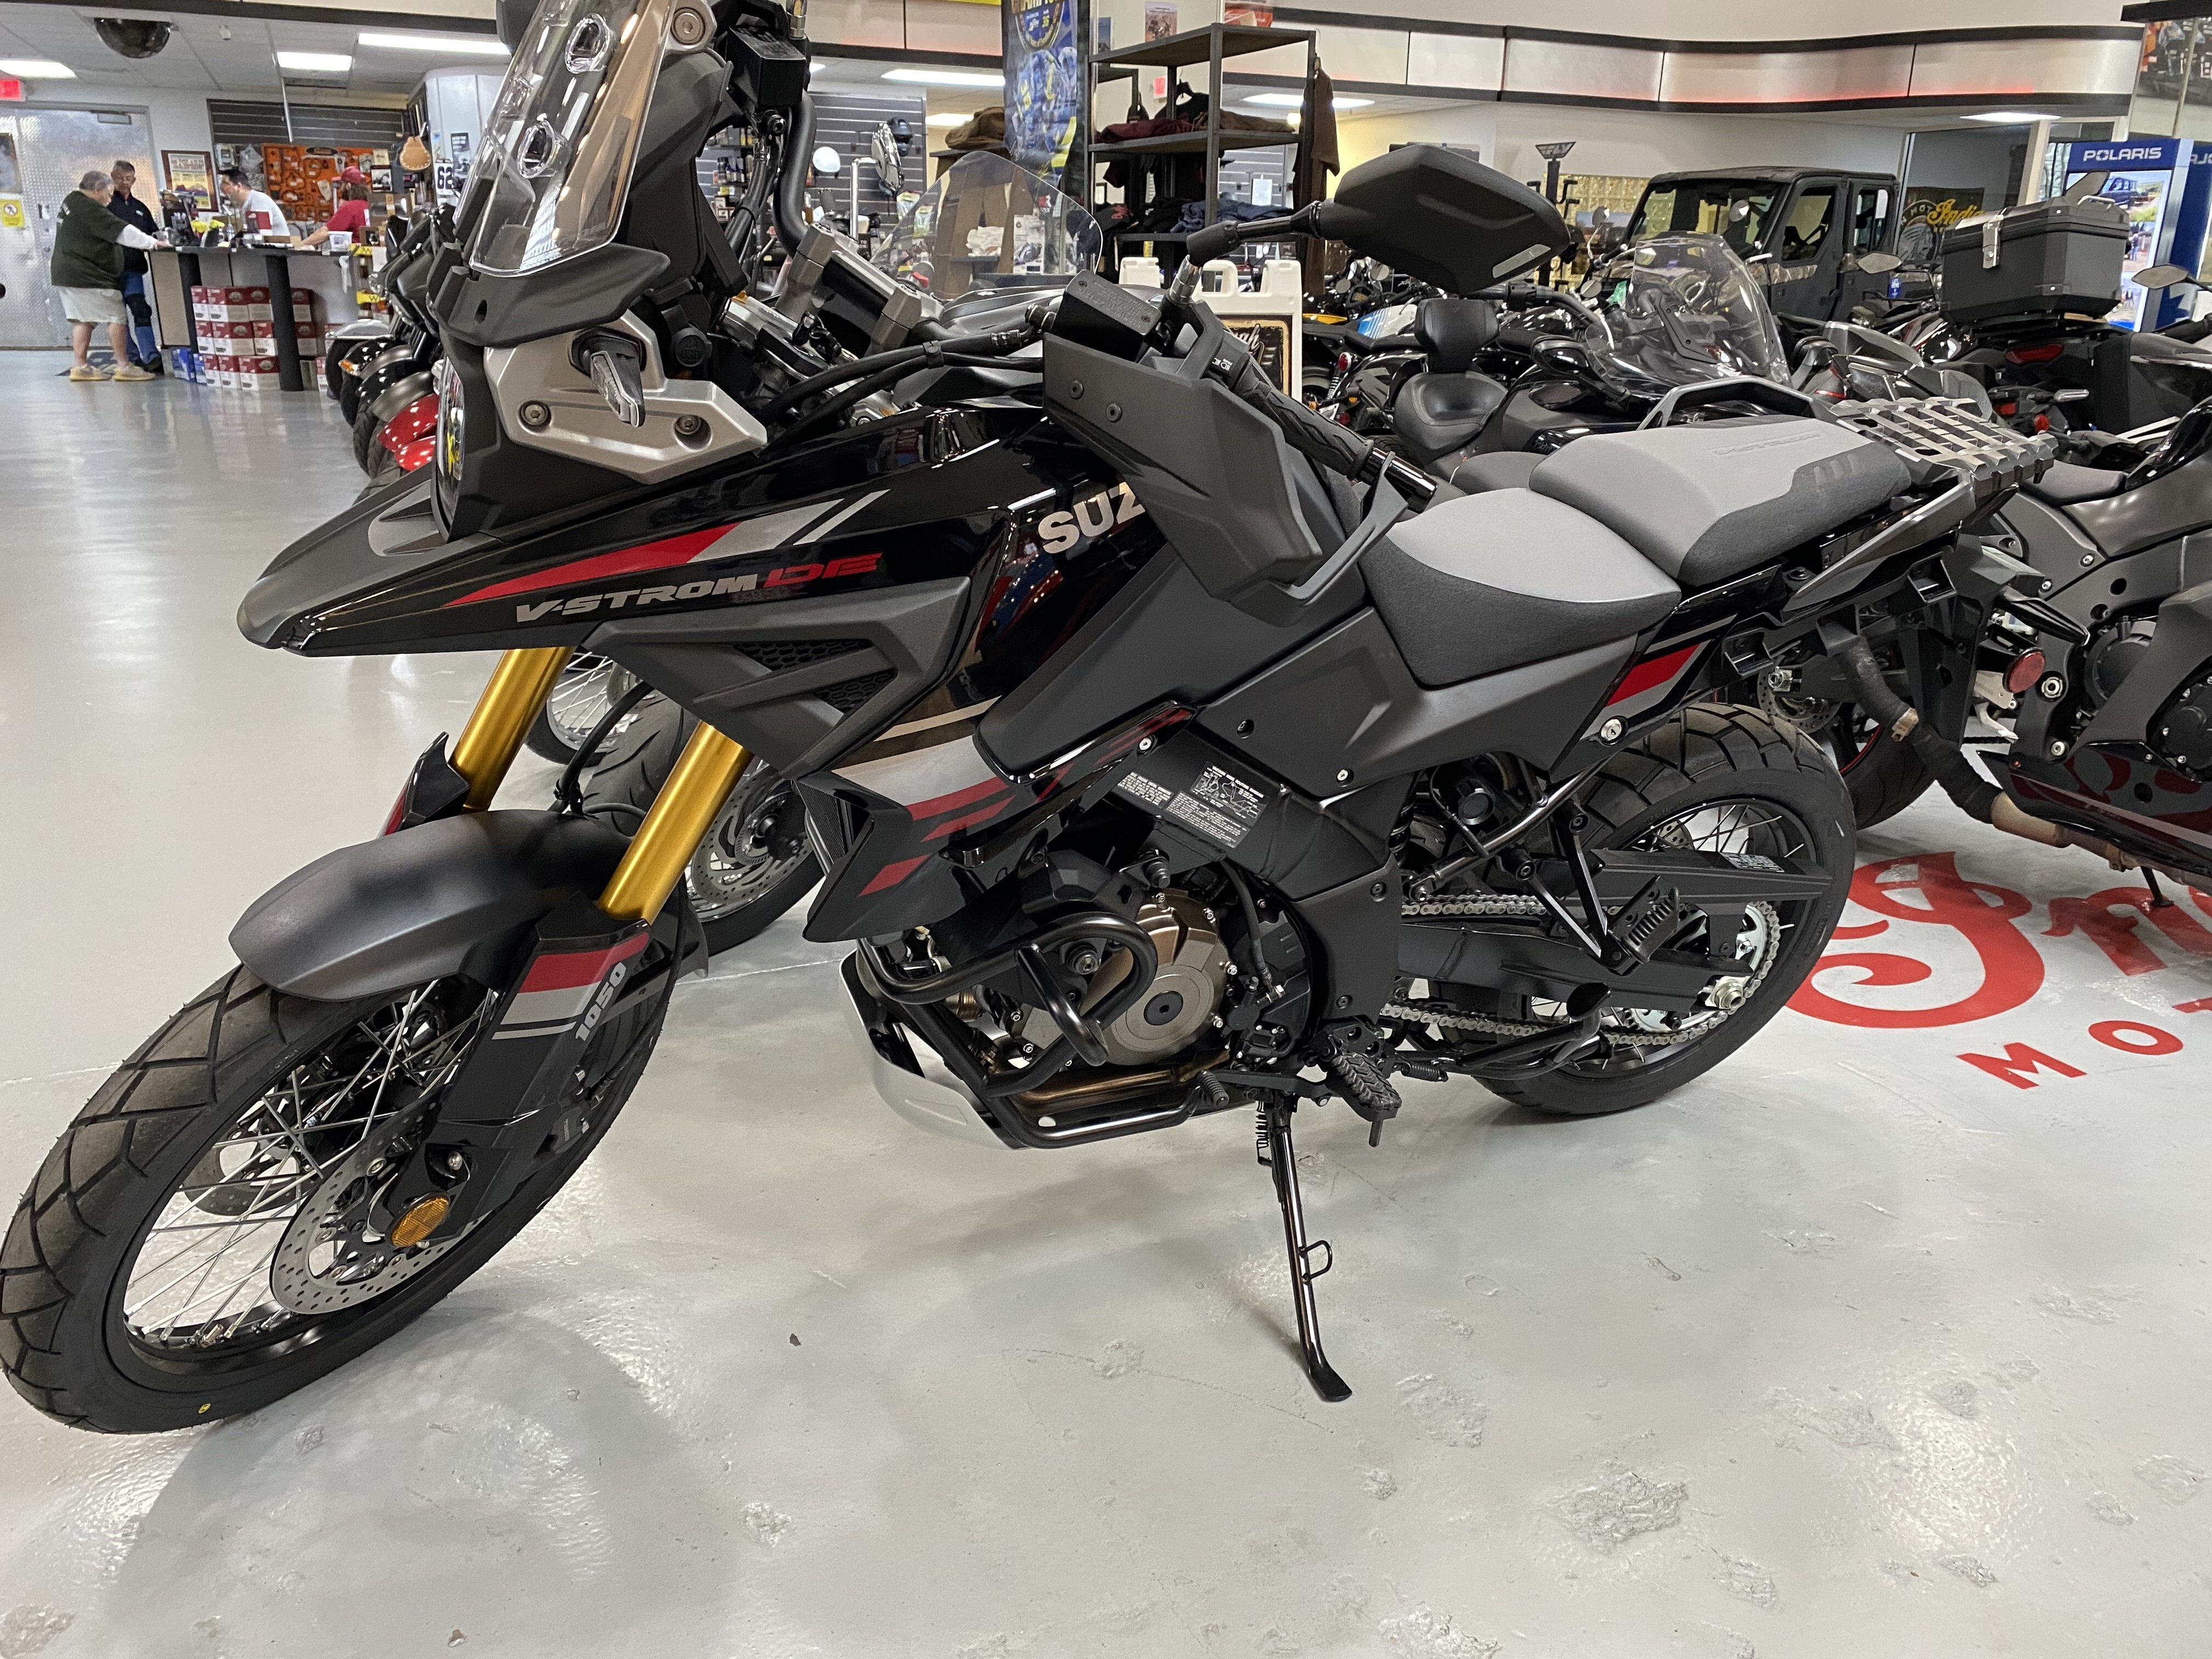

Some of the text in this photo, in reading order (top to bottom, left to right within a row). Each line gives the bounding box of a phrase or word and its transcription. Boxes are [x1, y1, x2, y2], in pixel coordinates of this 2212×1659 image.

[2083, 147, 2162, 161] POLARIS
[763, 553, 882, 588] DE
[575, 961, 627, 1041] 1050
